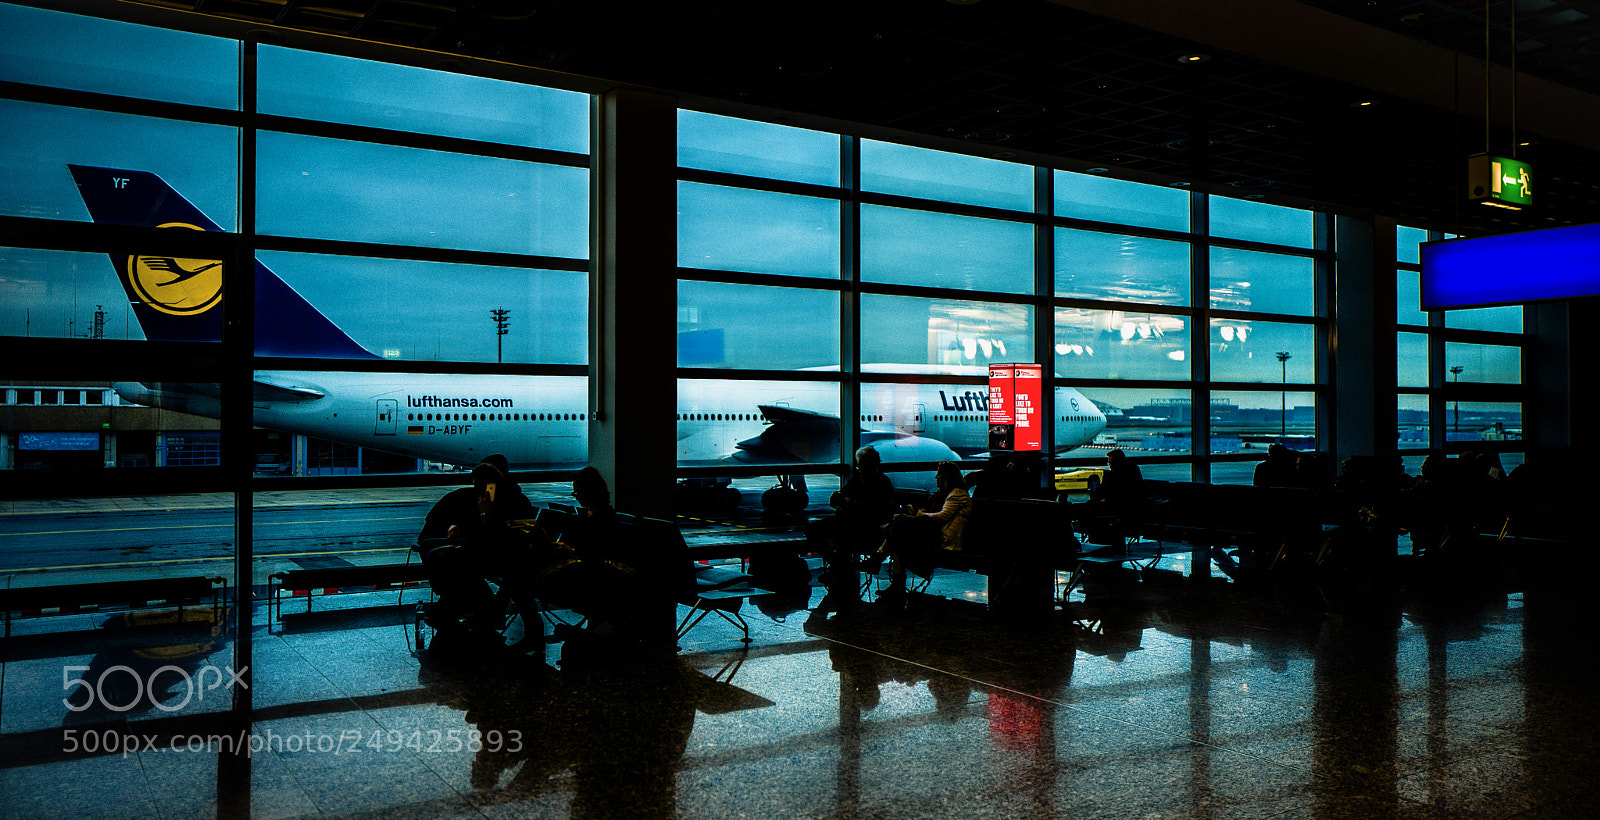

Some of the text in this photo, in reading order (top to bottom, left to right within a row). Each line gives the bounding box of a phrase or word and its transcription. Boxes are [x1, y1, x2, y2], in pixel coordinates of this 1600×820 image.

[112, 177, 130, 189] YF
[407, 395, 514, 408] lufthansa.com
[428, 424, 472, 435] D-ABYF
[1015, 420, 1030, 428] PHONE
